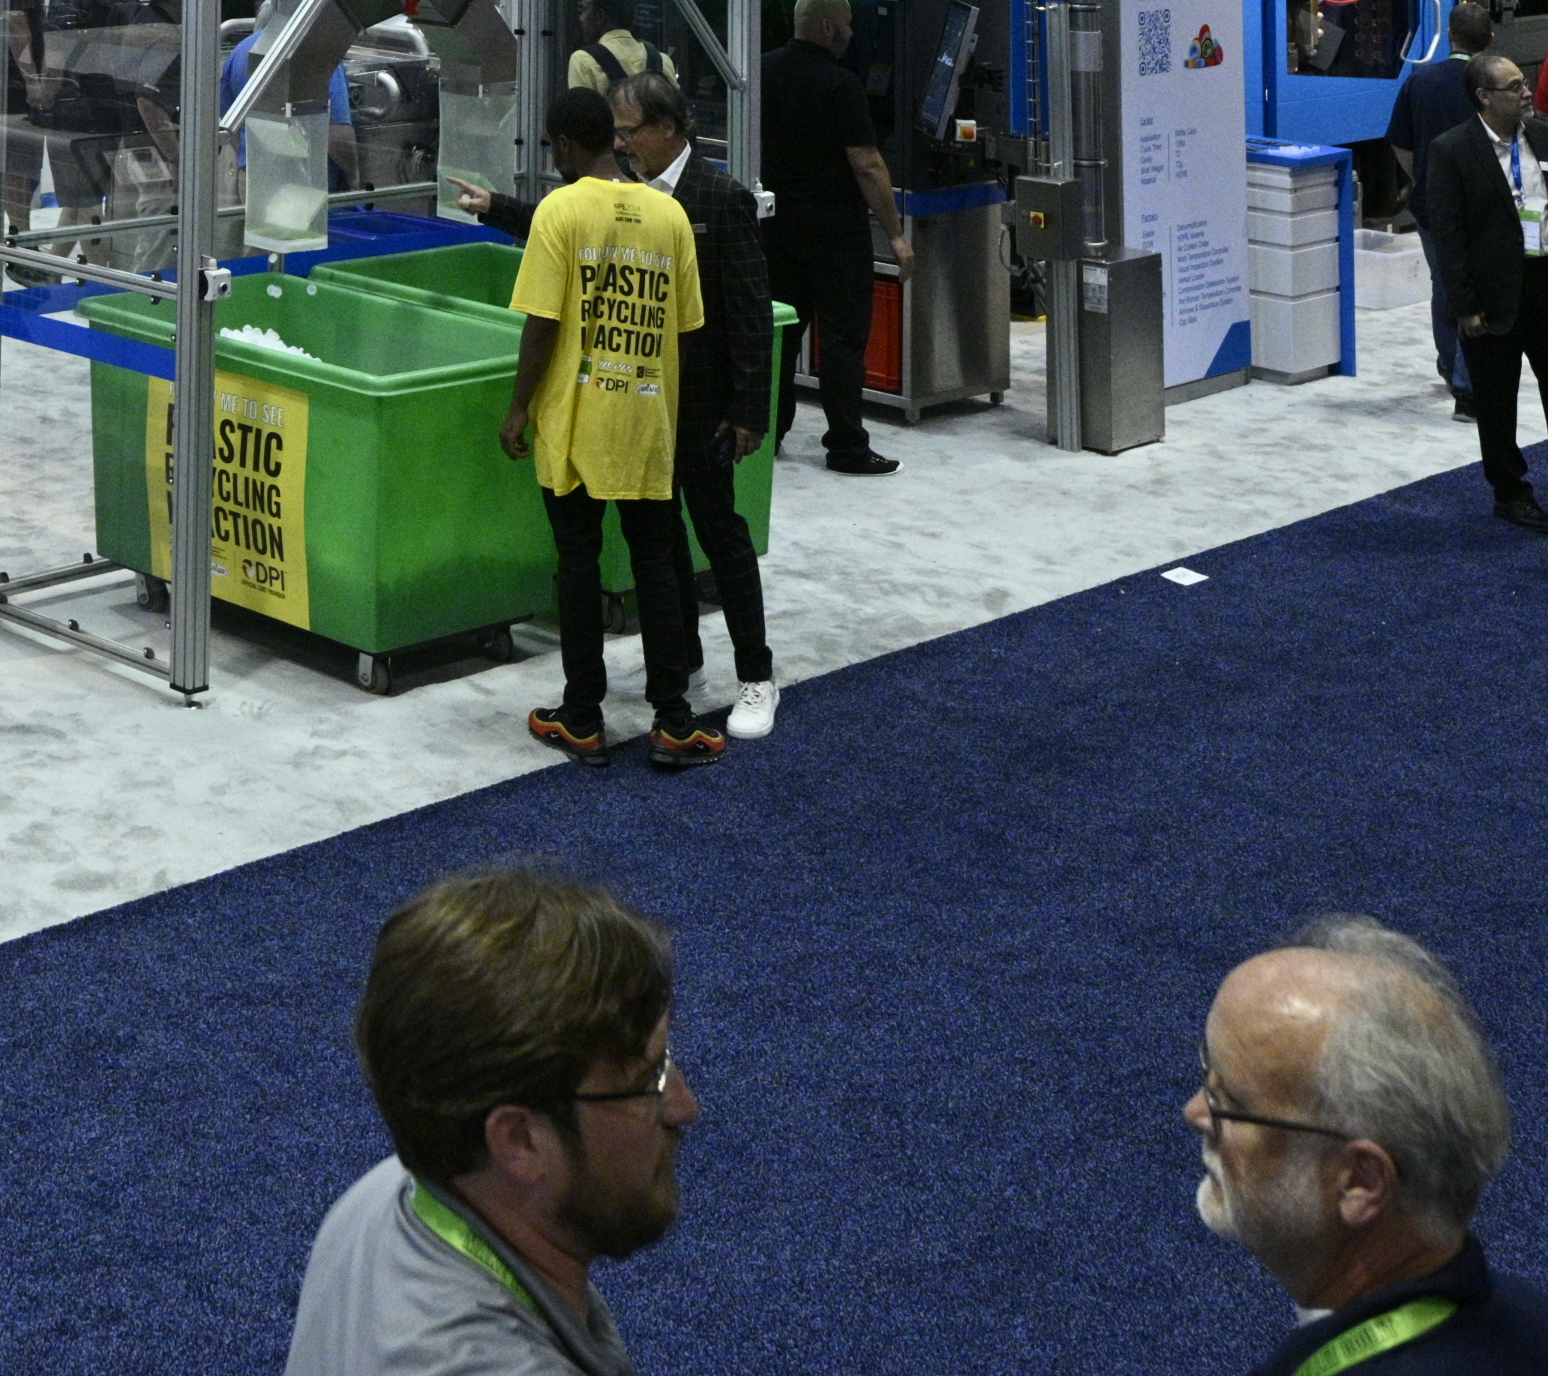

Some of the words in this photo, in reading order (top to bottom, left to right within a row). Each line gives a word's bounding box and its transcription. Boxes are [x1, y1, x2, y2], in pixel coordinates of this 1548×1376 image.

[620, 247, 637, 263] ME
[640, 250, 654, 265] TO
[655, 254, 673, 270] SEE
[594, 325, 663, 358] ACTION
[606, 377, 629, 393] DPI
[220, 394, 238, 414] ME
[243, 399, 257, 419] TO
[262, 404, 284, 427] SEE
[211, 506, 285, 562] CTION
[256, 562, 285, 591] DPI
